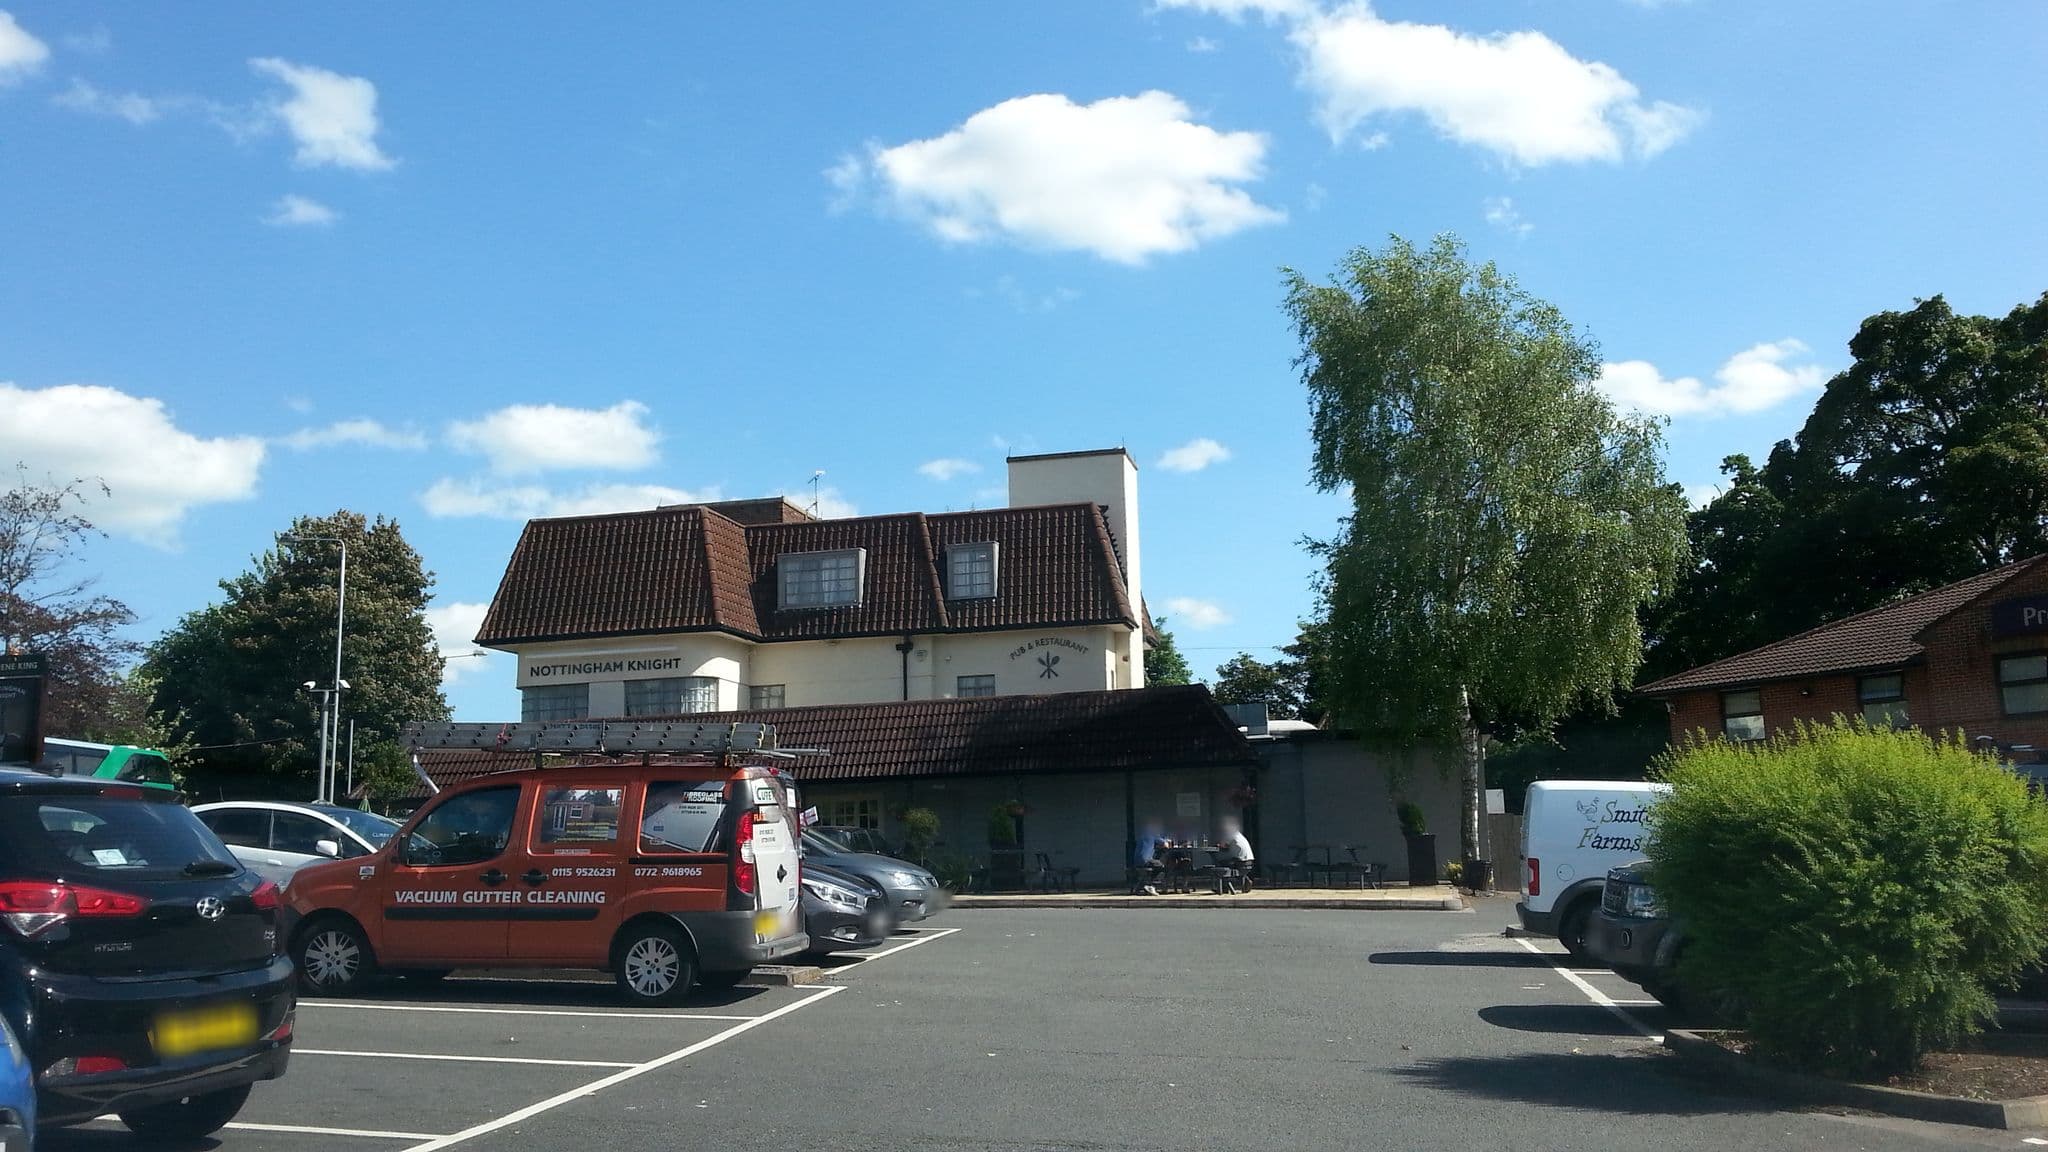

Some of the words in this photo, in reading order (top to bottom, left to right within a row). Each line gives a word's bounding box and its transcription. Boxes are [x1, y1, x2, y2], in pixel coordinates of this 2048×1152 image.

[2023, 606, 2048, 627] Pr
[1010, 646, 1026, 660] PUB
[1027, 642, 1034, 650] &
[1035, 637, 1089, 655] RESTAURANT
[530, 660, 624, 677] NOTTINGHAM
[627, 658, 681, 671] KNIGHT
[552, 868, 572, 877] 0115
[575, 868, 616, 877] 9526231
[634, 867, 658, 876] 0772
[395, 891, 457, 903] VACUUM
[462, 890, 521, 903] GUTTER
[527, 890, 606, 904] CLEANING
